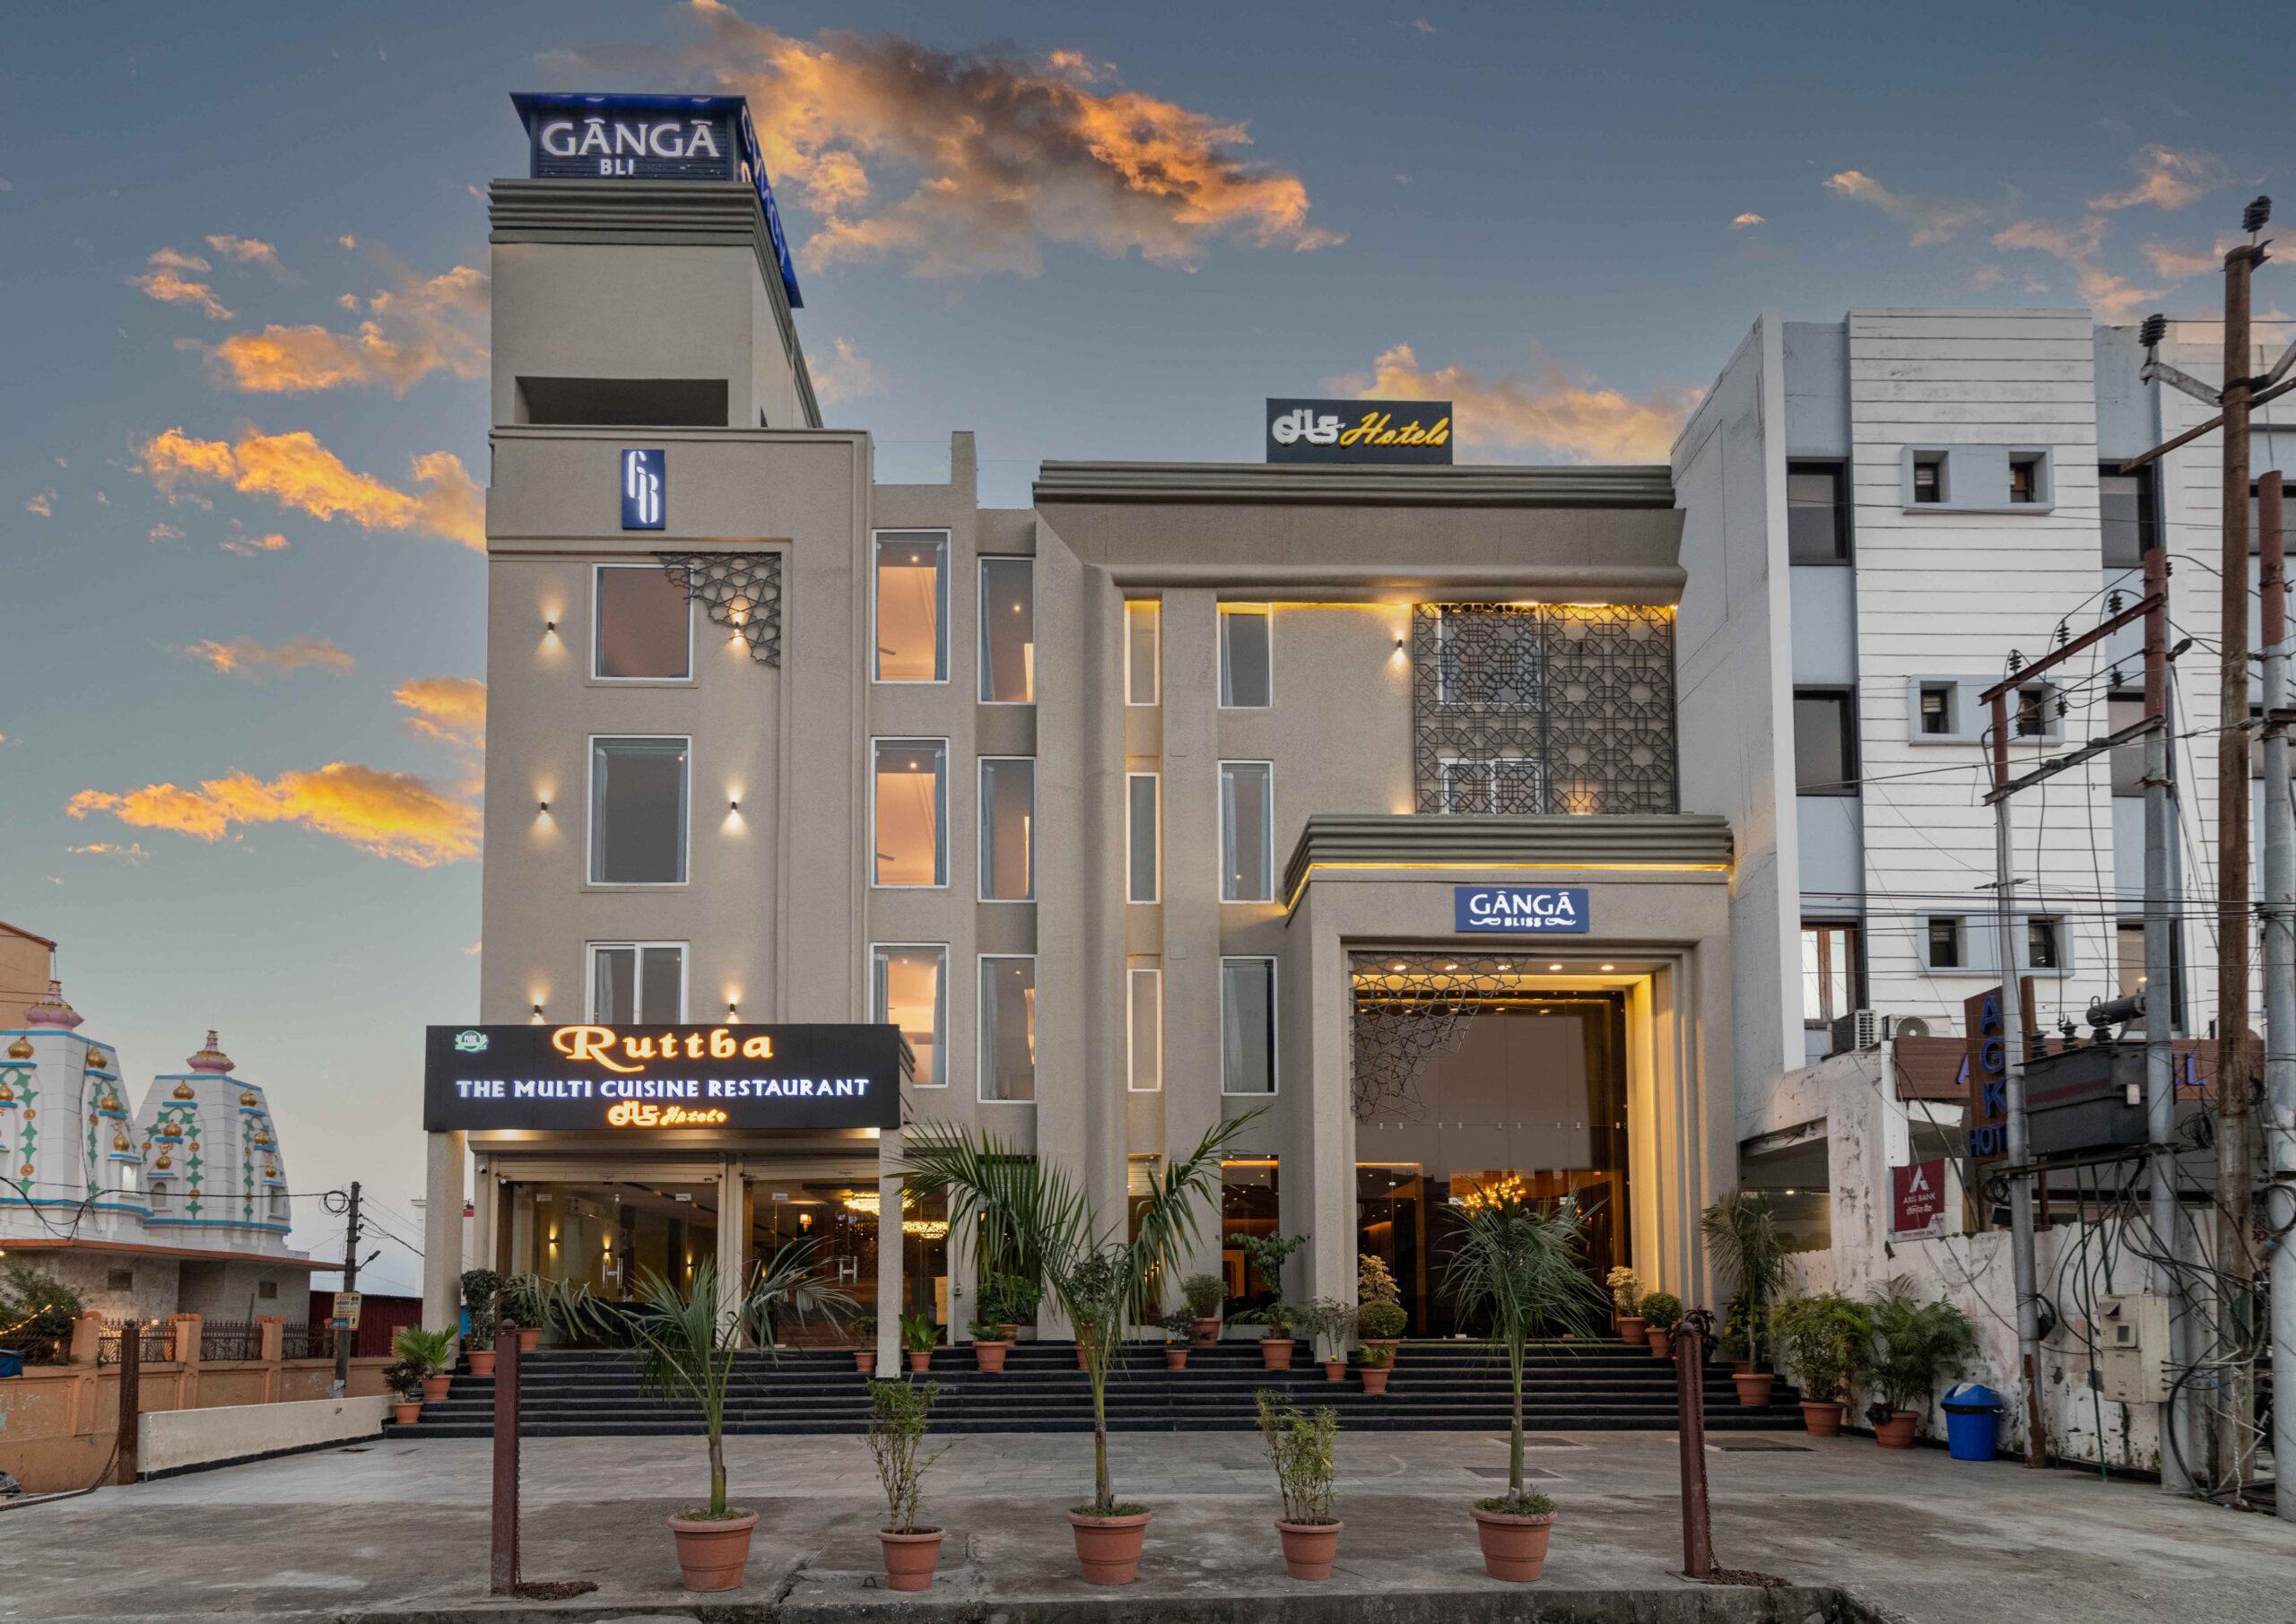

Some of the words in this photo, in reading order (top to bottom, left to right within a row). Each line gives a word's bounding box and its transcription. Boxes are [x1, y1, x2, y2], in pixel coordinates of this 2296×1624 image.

[1339, 411, 1450, 447] Hotels
[1504, 916, 1542, 928] BLISS
[552, 1026, 774, 1073] Ruttba
[456, 1080, 506, 1099] THE
[513, 1080, 594, 1099] MULTI
[599, 1079, 700, 1098] CUISINE
[708, 1079, 869, 1097] RESTAURANT
[1903, 1195, 1917, 1204] AXIS
[1918, 1192, 1936, 1203] BANK
